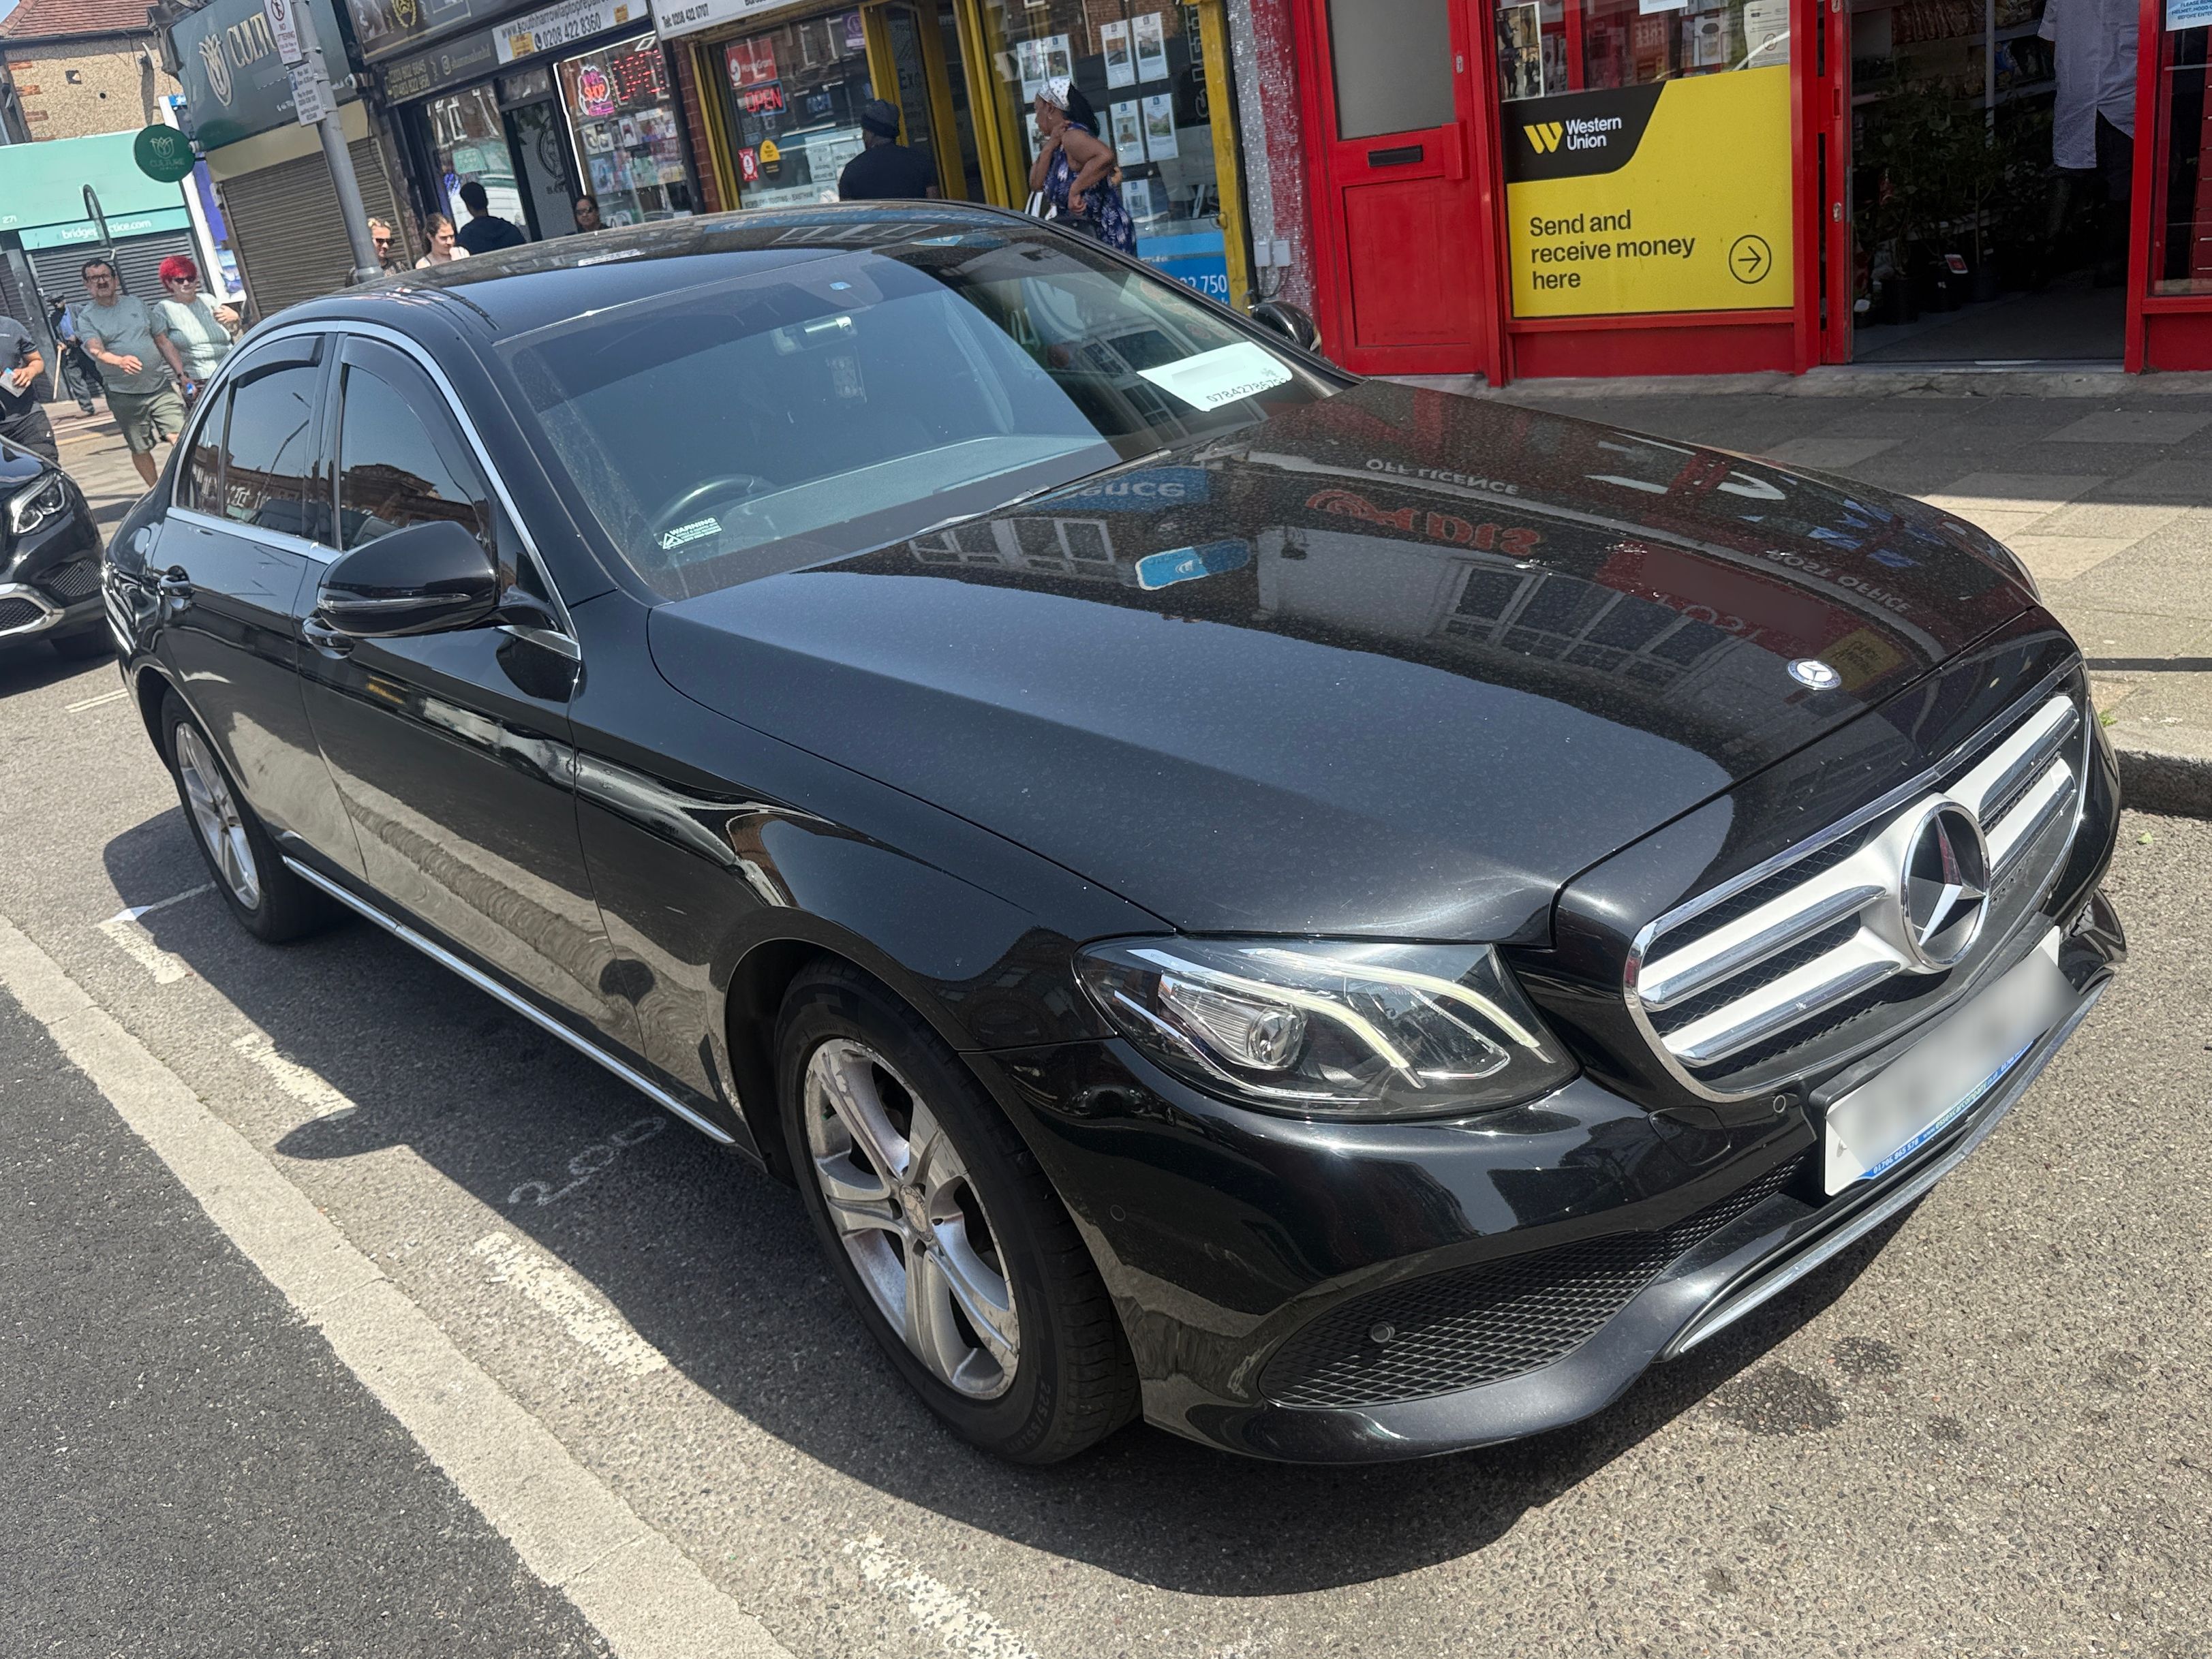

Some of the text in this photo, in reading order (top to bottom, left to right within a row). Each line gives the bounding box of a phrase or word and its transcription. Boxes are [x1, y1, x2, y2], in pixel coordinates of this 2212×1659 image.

[543, 27, 562, 48] 0208
[564, 20, 579, 40] 422
[581, 12, 602, 35] 8360
[744, 87, 783, 112] OPEN
[1565, 117, 1623, 136] Western
[1567, 134, 1608, 151] Union
[2, 215, 17, 224] 271
[61, 219, 152, 240] bridgepctice.com
[1529, 208, 1631, 237] Send and
[1531, 236, 1695, 264] receive money
[1532, 270, 1581, 290] here
[669, 517, 716, 536] WARNING
